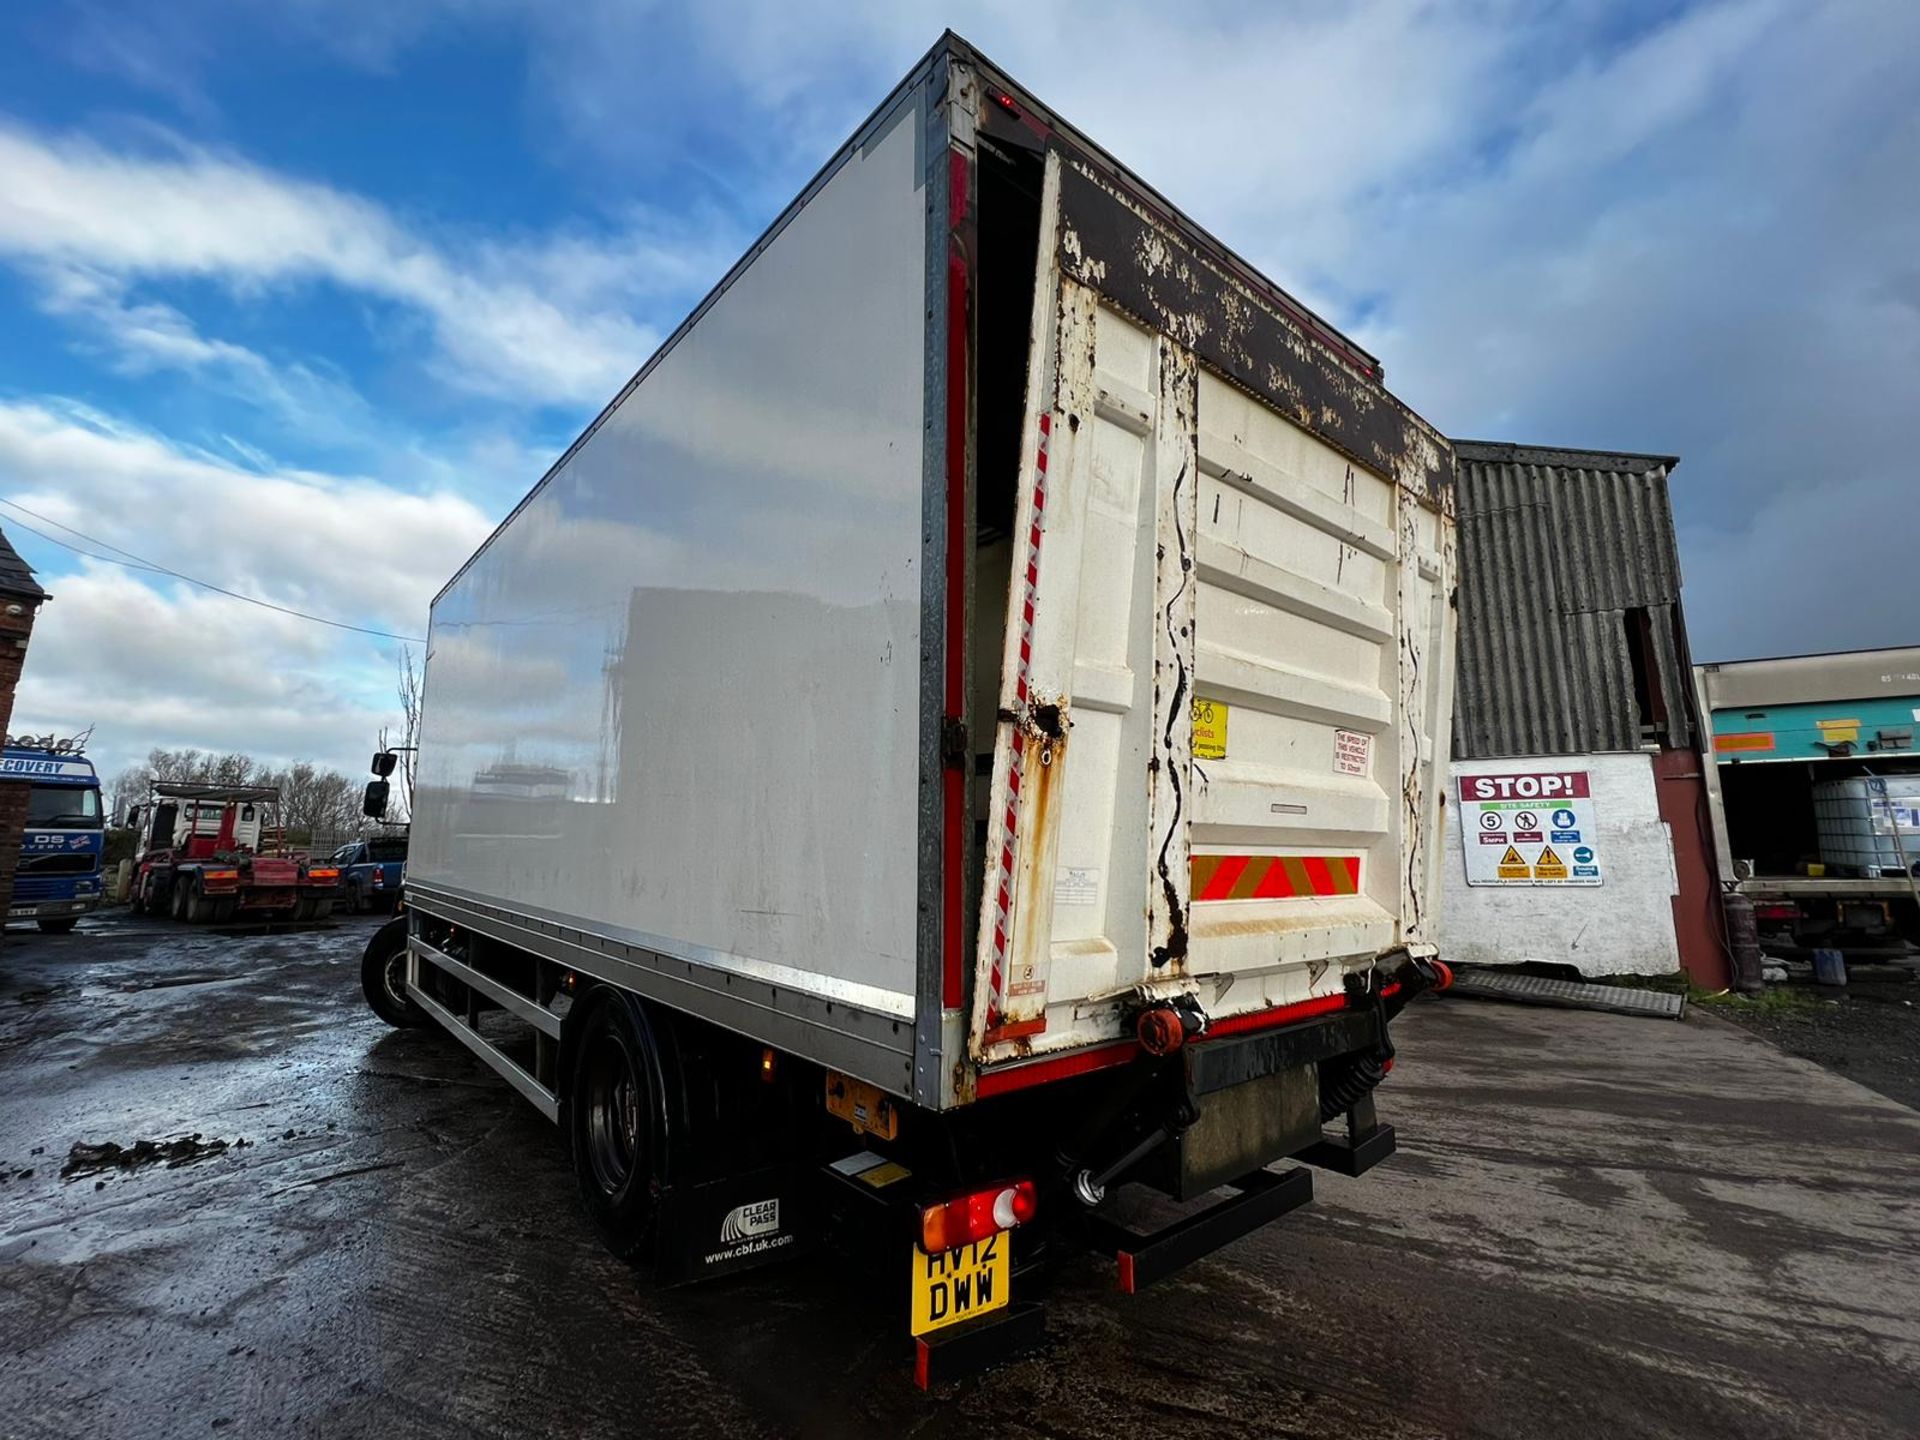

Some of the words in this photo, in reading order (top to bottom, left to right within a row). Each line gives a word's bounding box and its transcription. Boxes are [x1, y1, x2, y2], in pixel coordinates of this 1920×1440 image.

[0, 759, 64, 774] COVERY
[1475, 776, 1573, 798] STOP!
[1486, 816, 1496, 827] 5
[34, 835, 64, 843] DS
[743, 1201, 776, 1218] CLEAR
[750, 1211, 776, 1226] PASS
[705, 1235, 793, 1264] www.cbf.uk.com
[930, 1267, 993, 1322] DWW
